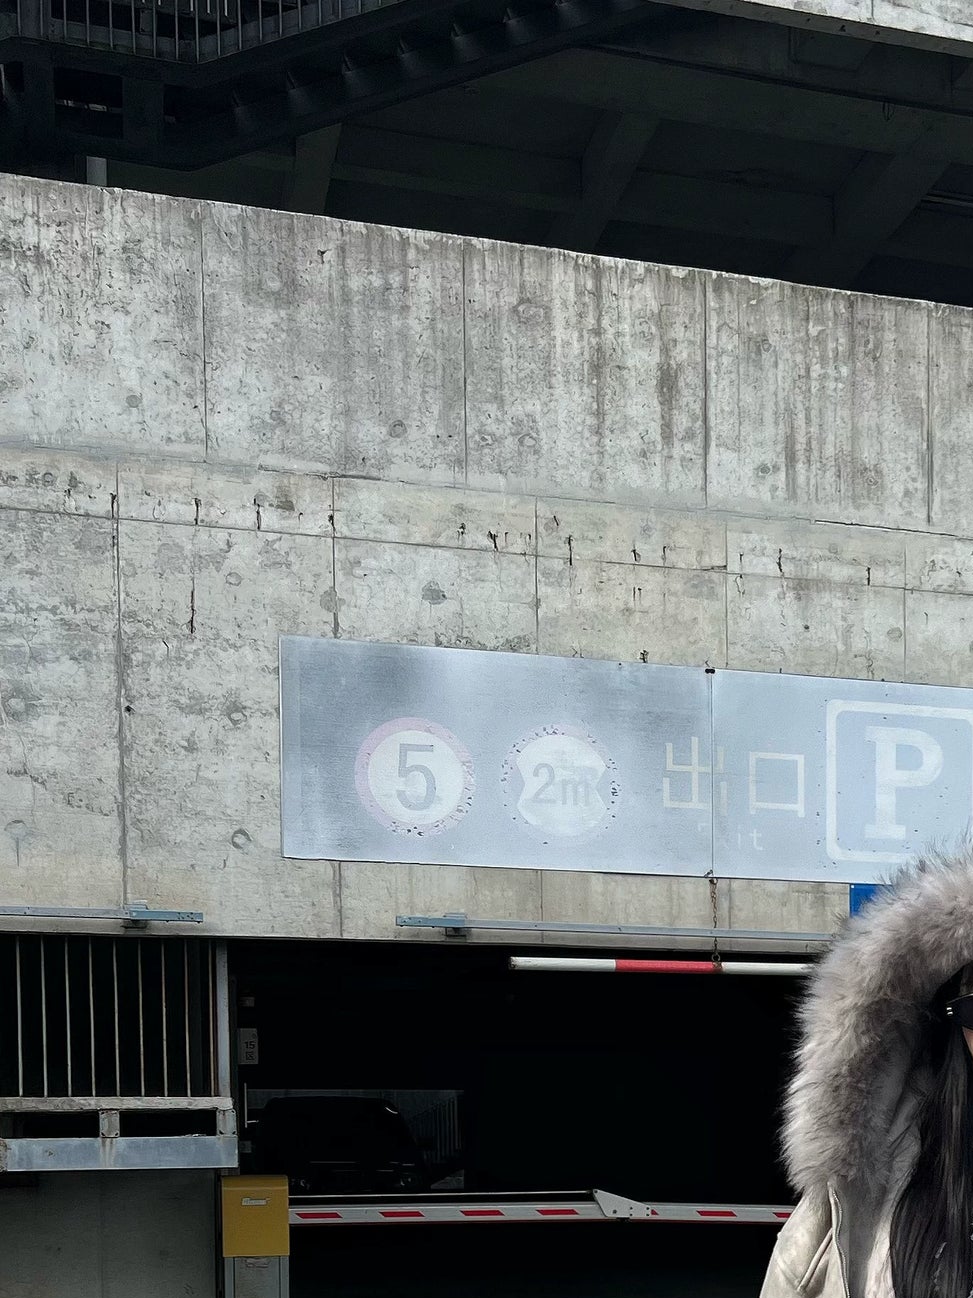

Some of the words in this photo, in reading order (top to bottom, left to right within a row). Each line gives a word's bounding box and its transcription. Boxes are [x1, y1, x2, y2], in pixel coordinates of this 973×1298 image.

[396, 743, 438, 813] 5
[531, 762, 592, 807] 2m
[662, 736, 806, 818] 出口
[863, 724, 944, 841] P
[244, 1040, 257, 1050] 15
